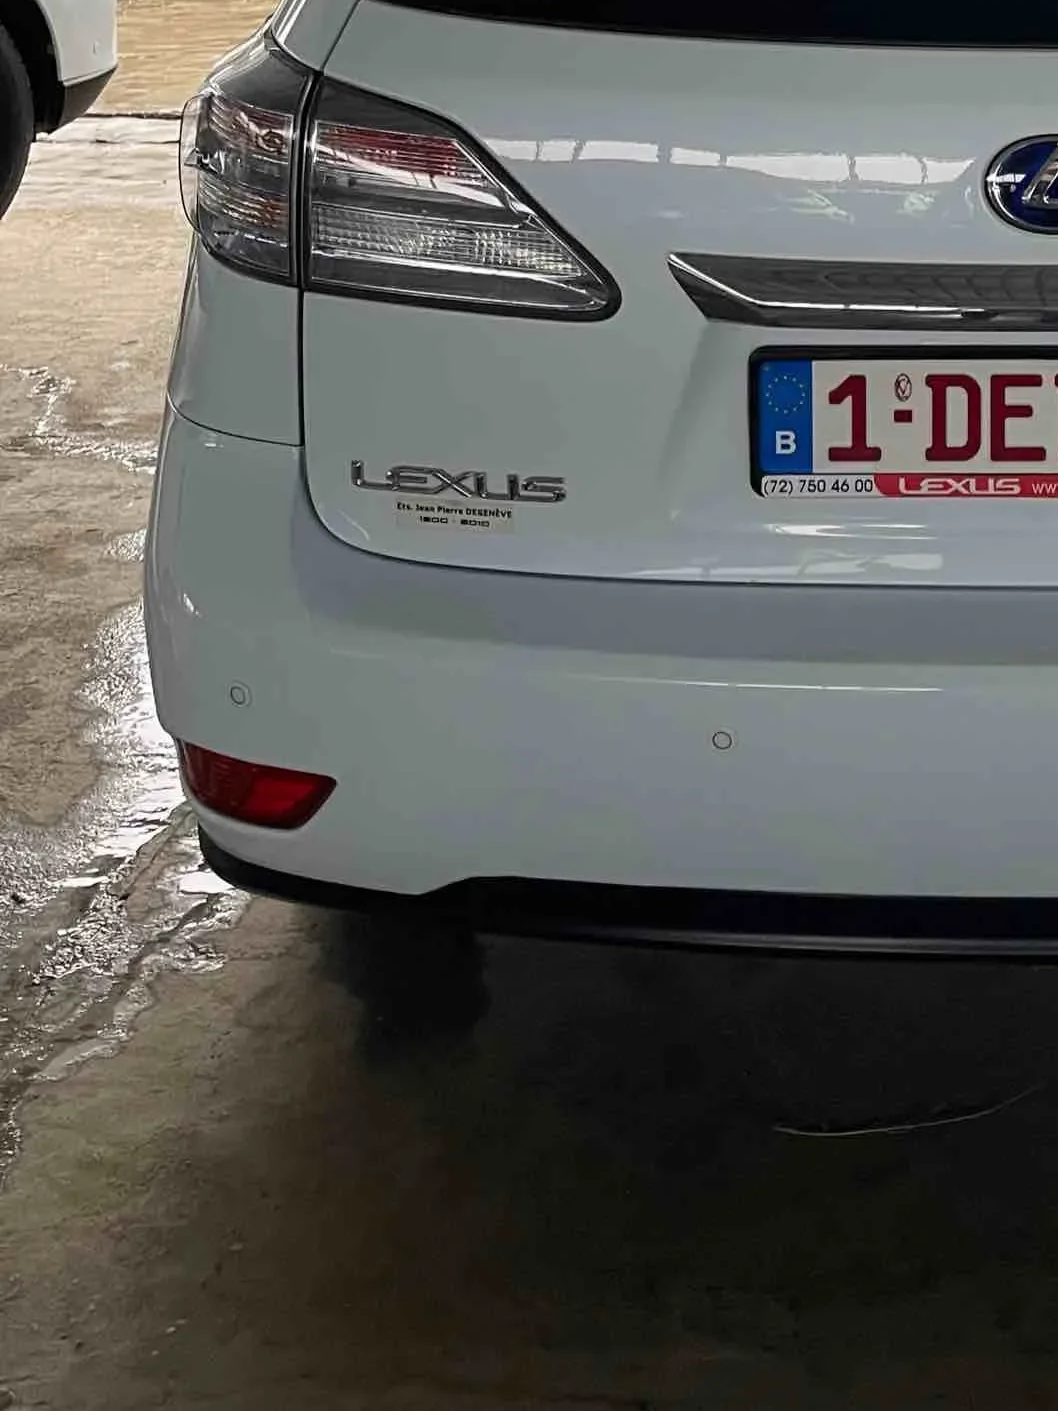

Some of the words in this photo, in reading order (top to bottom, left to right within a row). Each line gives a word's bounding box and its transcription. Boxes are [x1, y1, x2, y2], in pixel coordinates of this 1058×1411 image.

[775, 430, 797, 455] B
[351, 459, 567, 504] LEXUS
[763, 479, 793, 496] (72)
[799, 479, 826, 494] 750
[831, 479, 850, 494] 46
[854, 479, 873, 494] 00
[899, 477, 1020, 496] LEXUS
